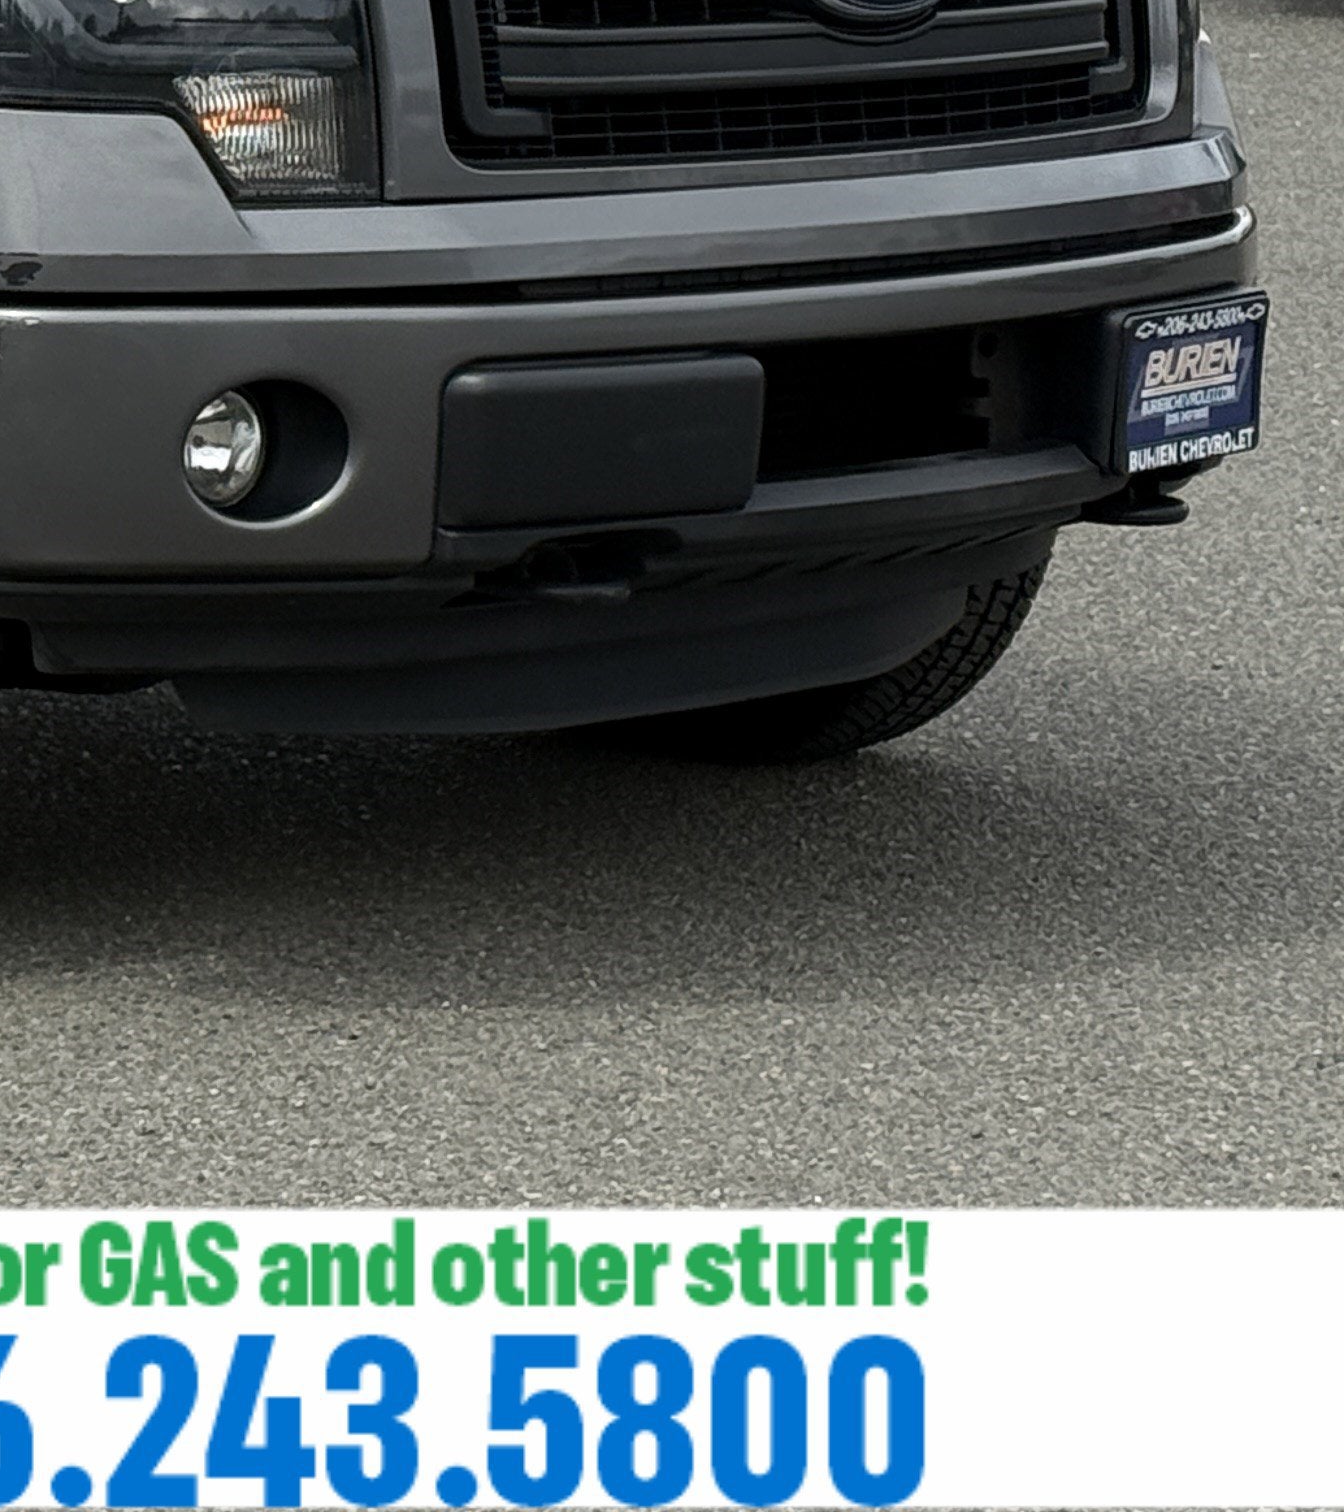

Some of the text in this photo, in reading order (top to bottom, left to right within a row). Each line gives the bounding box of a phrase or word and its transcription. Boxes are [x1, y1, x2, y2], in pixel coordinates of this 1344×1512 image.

[1145, 336, 1241, 387] BURIEN
[1128, 427, 1254, 473] BURIEN CHEVROLET
